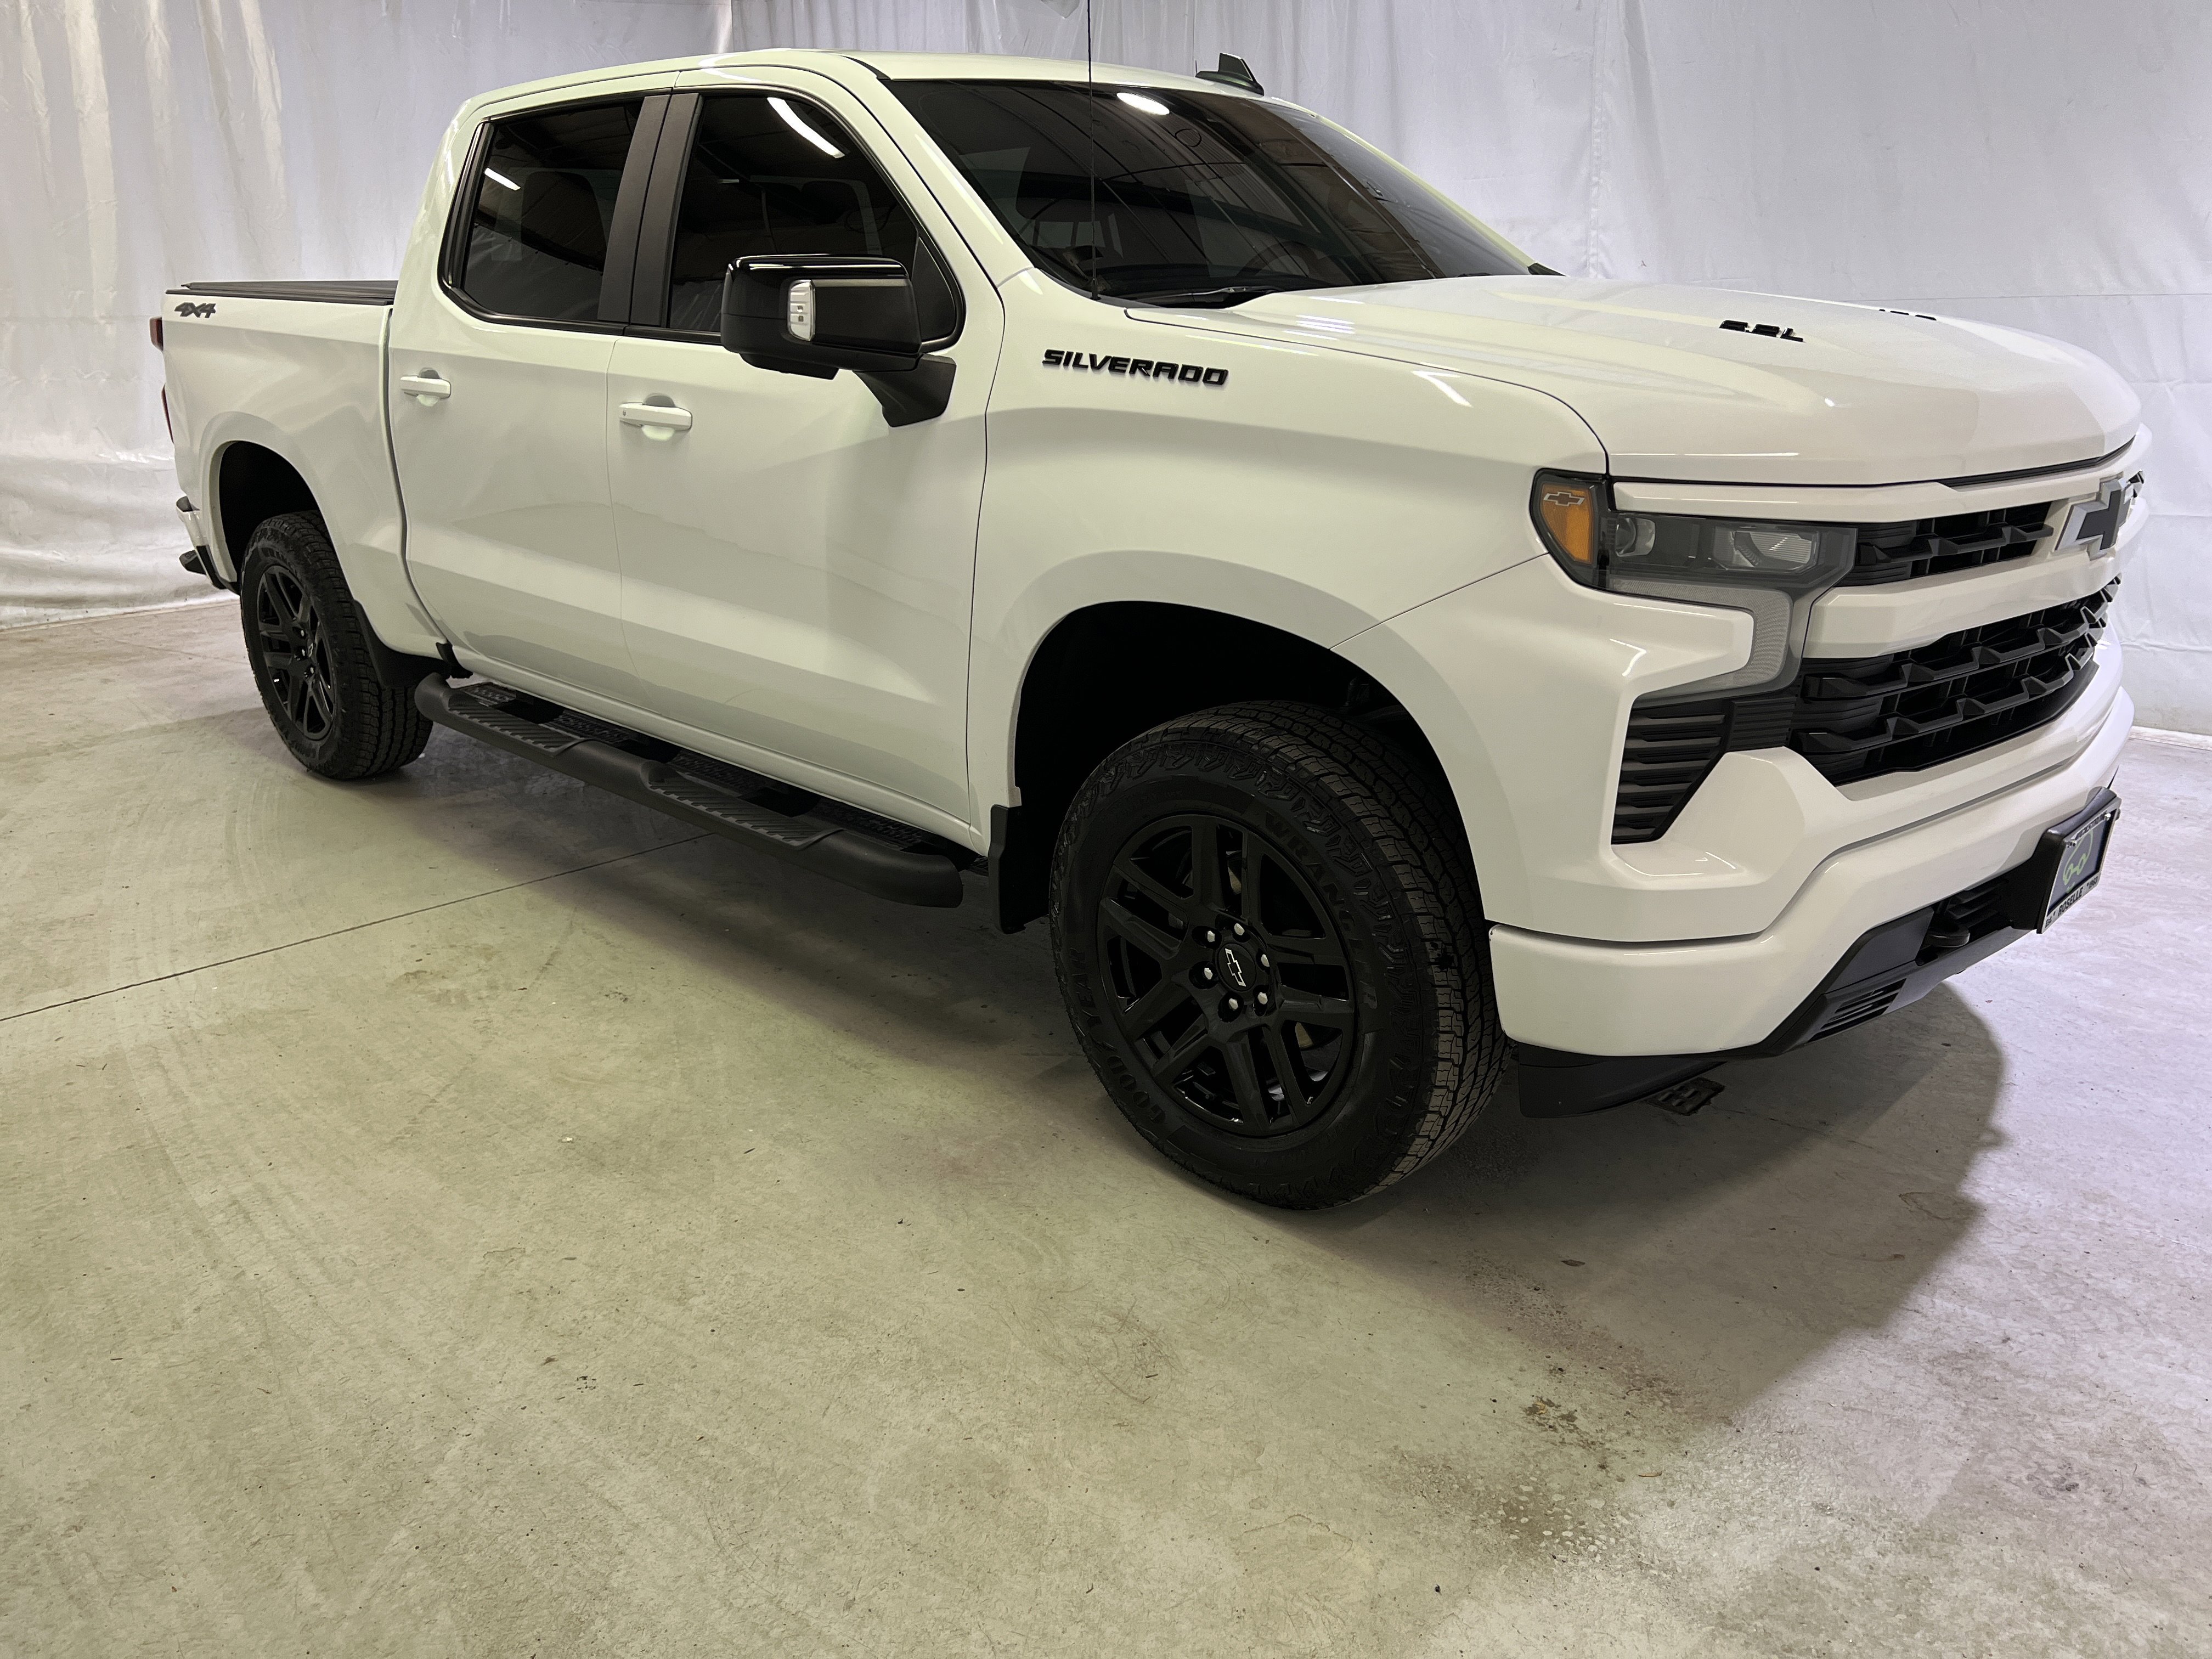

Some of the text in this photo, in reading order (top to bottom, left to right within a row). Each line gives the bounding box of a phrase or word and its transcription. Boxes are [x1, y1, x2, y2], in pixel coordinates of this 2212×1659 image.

[1719, 320, 1804, 342] 6.2L
[1042, 349, 1229, 385] SILVERADO
[2058, 886, 2084, 917] ROSELLE
